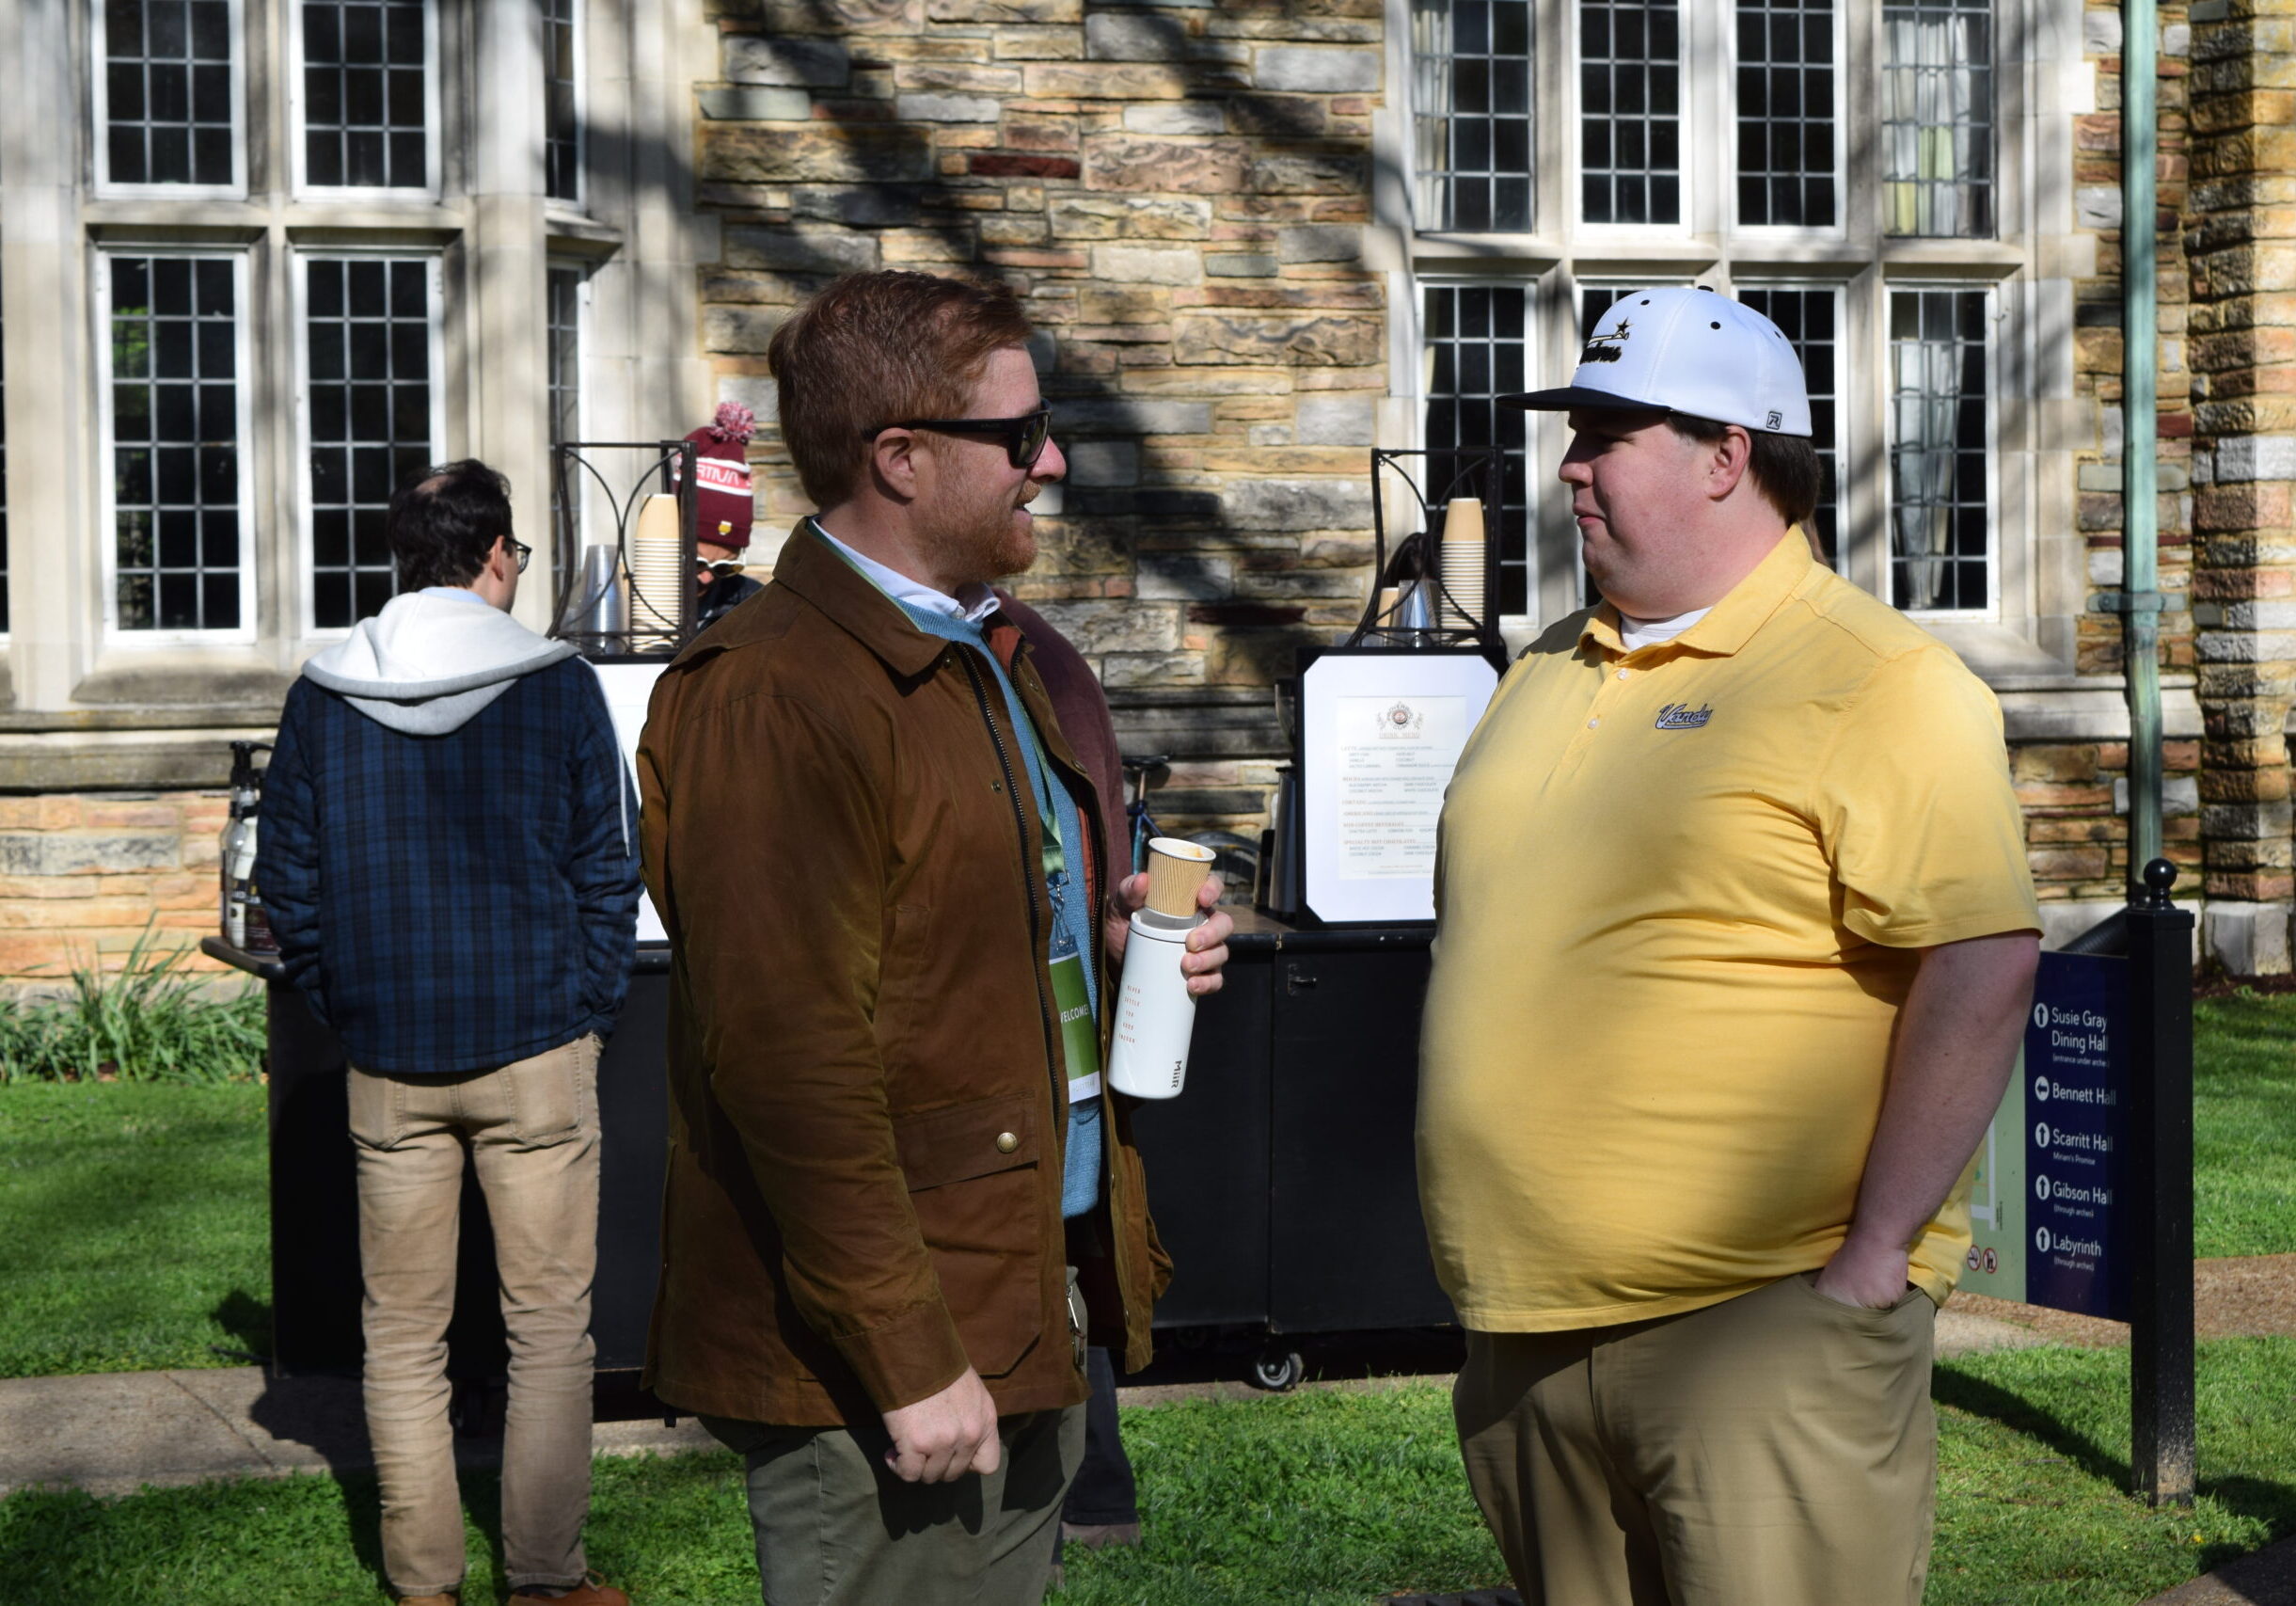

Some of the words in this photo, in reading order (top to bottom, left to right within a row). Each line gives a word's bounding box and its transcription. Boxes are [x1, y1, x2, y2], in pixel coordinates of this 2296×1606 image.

[2051, 1007, 2080, 1026] Susie
[2082, 1010, 2108, 1033] Gray
[2051, 1029, 2085, 1054] Dining
[2088, 1034, 2109, 1052] Hall
[1171, 1060, 1182, 1089] MiiR
[2052, 1082, 2094, 1104] Bennett
[2096, 1087, 2117, 1106] Hall
[2052, 1128, 2091, 1150] Scarritt
[2093, 1133, 2114, 1153] Hall
[2052, 1180, 2090, 1202] Gibson
[2092, 1186, 2113, 1205] Hall
[2052, 1232, 2102, 1258] Labyrinth
